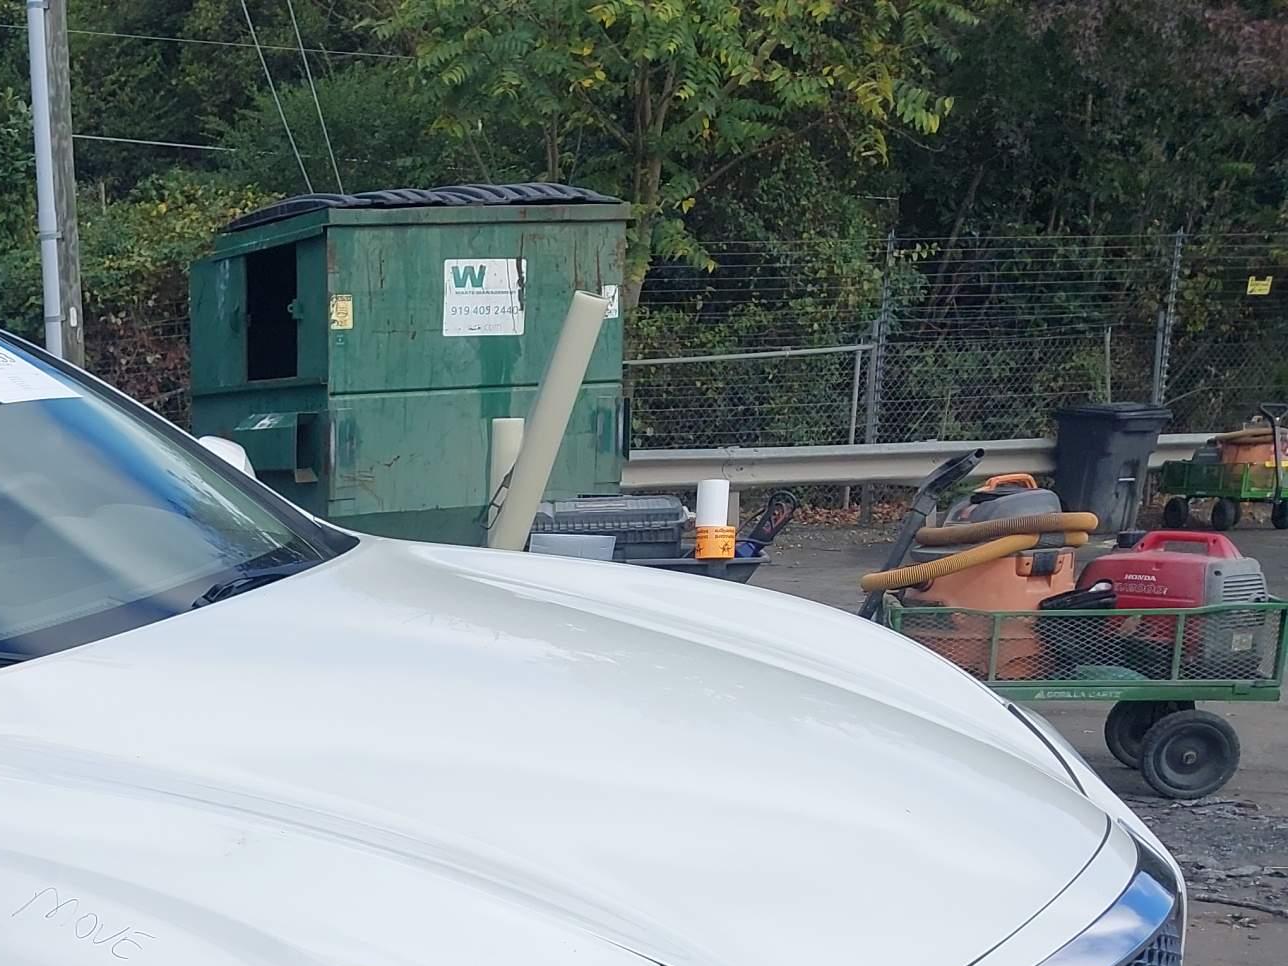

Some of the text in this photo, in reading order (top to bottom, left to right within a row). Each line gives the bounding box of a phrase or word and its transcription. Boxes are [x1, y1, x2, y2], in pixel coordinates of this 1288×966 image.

[451, 306, 470, 316] 919
[494, 305, 519, 316] 2440
[1124, 573, 1157, 582] HONDA
